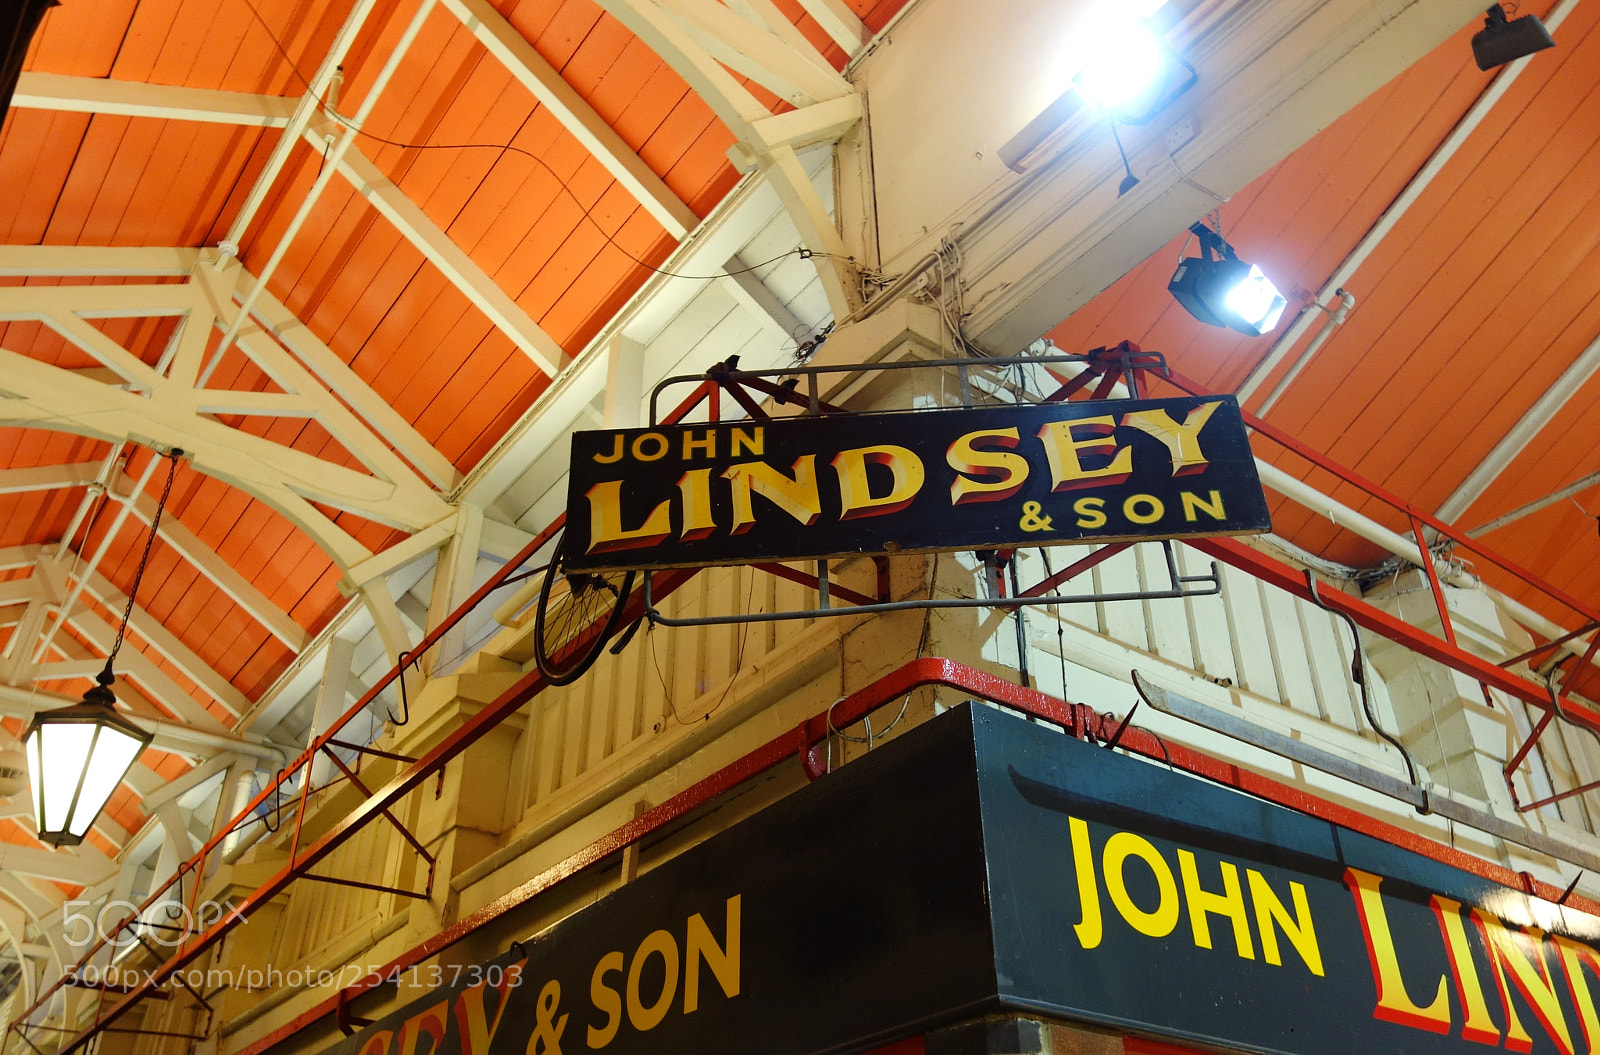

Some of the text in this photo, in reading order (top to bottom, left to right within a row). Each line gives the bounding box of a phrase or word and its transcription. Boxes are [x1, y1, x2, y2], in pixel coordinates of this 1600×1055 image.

[583, 400, 1225, 556] LINDSEY
[593, 427, 765, 464] JOHN
[1019, 490, 1227, 532] & SON
[525, 979, 570, 1055] &
[586, 894, 742, 1050] SON
[1068, 816, 1325, 977] JOHN
